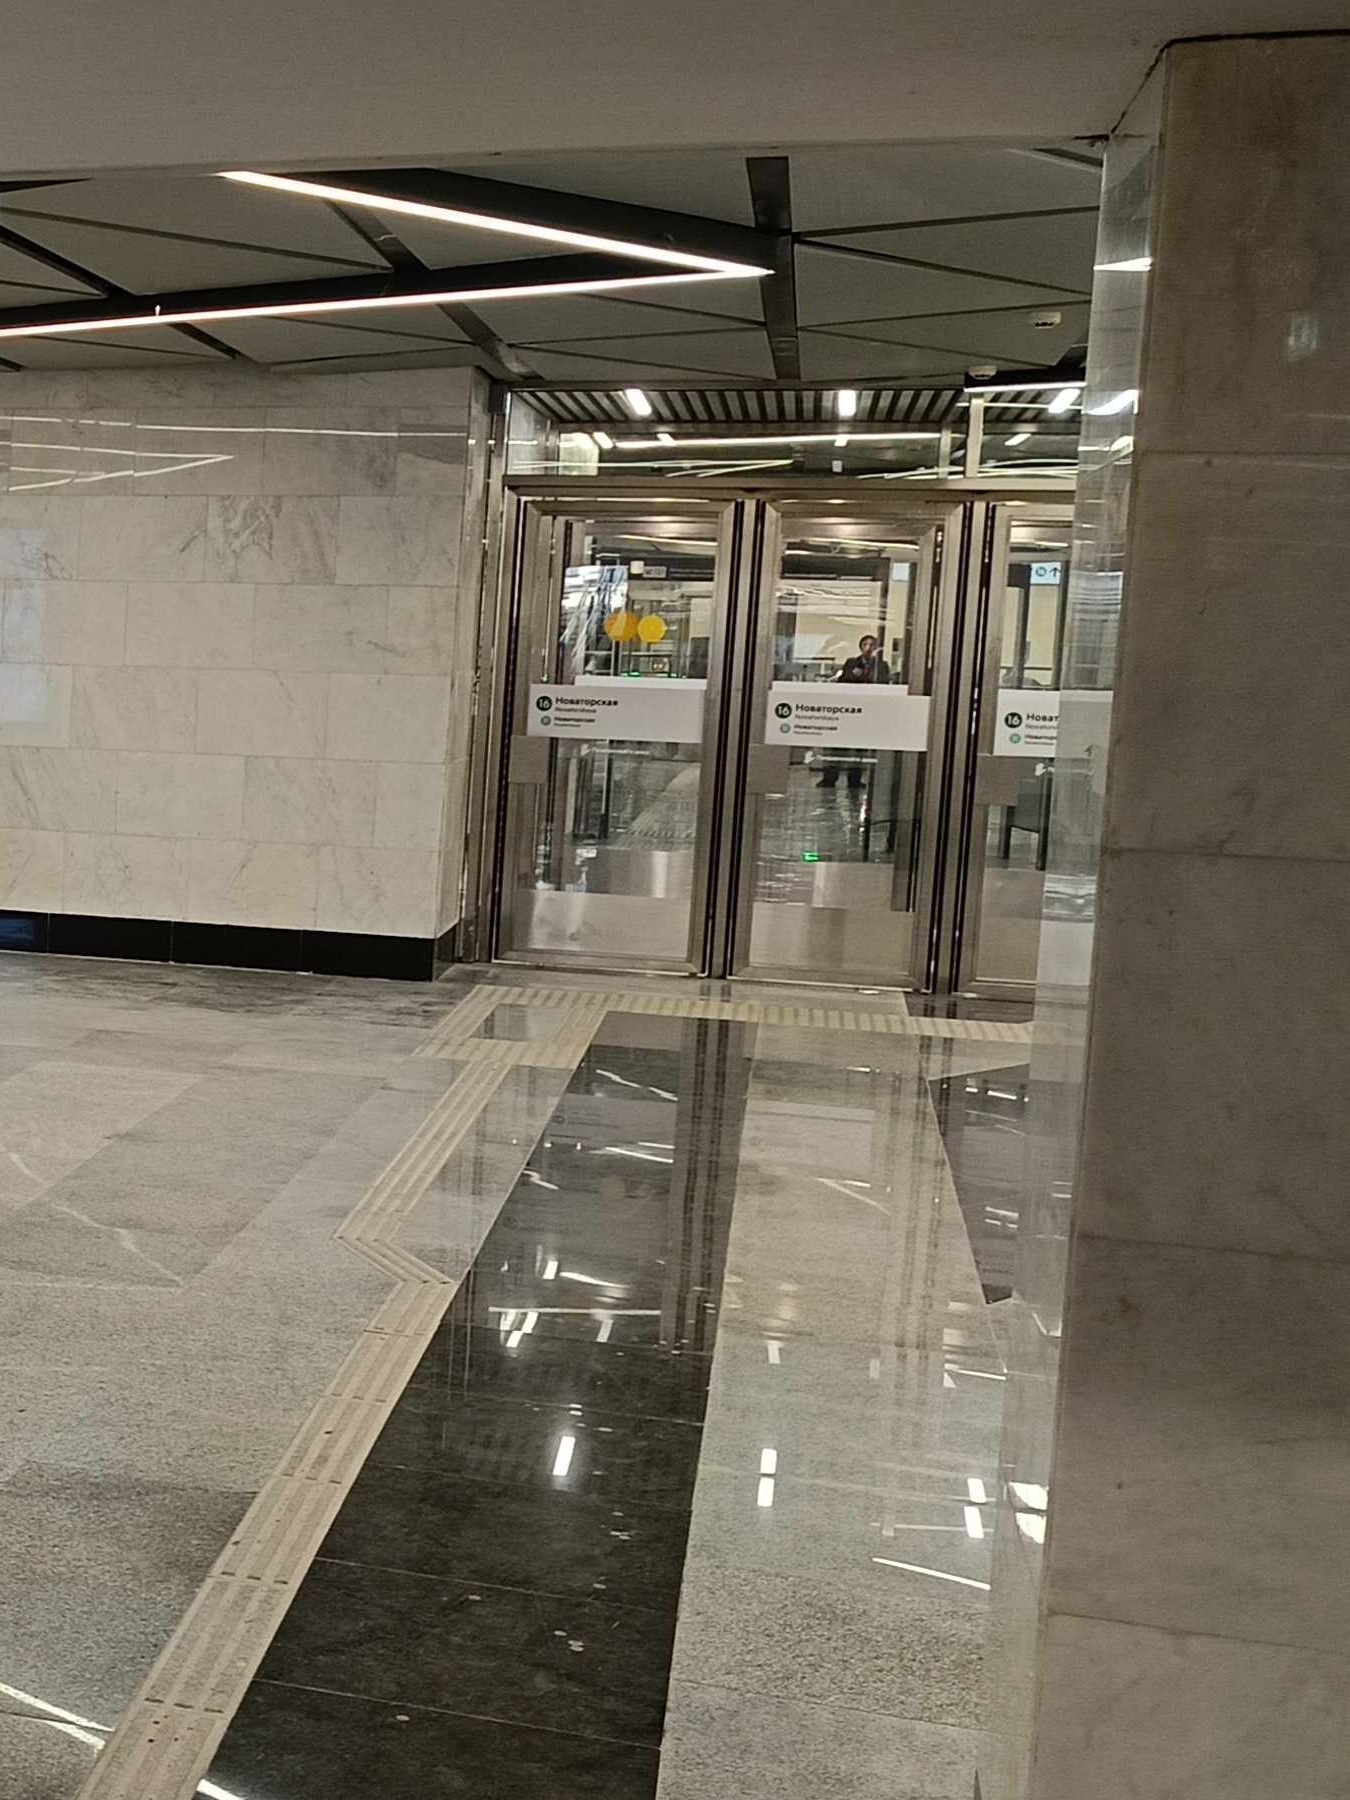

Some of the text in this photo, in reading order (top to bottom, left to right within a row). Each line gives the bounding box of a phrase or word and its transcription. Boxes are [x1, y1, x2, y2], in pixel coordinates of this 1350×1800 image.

[555, 697, 618, 706] Новаторская
[796, 704, 862, 714] Новаторская
[1026, 714, 1059, 722] Новат
